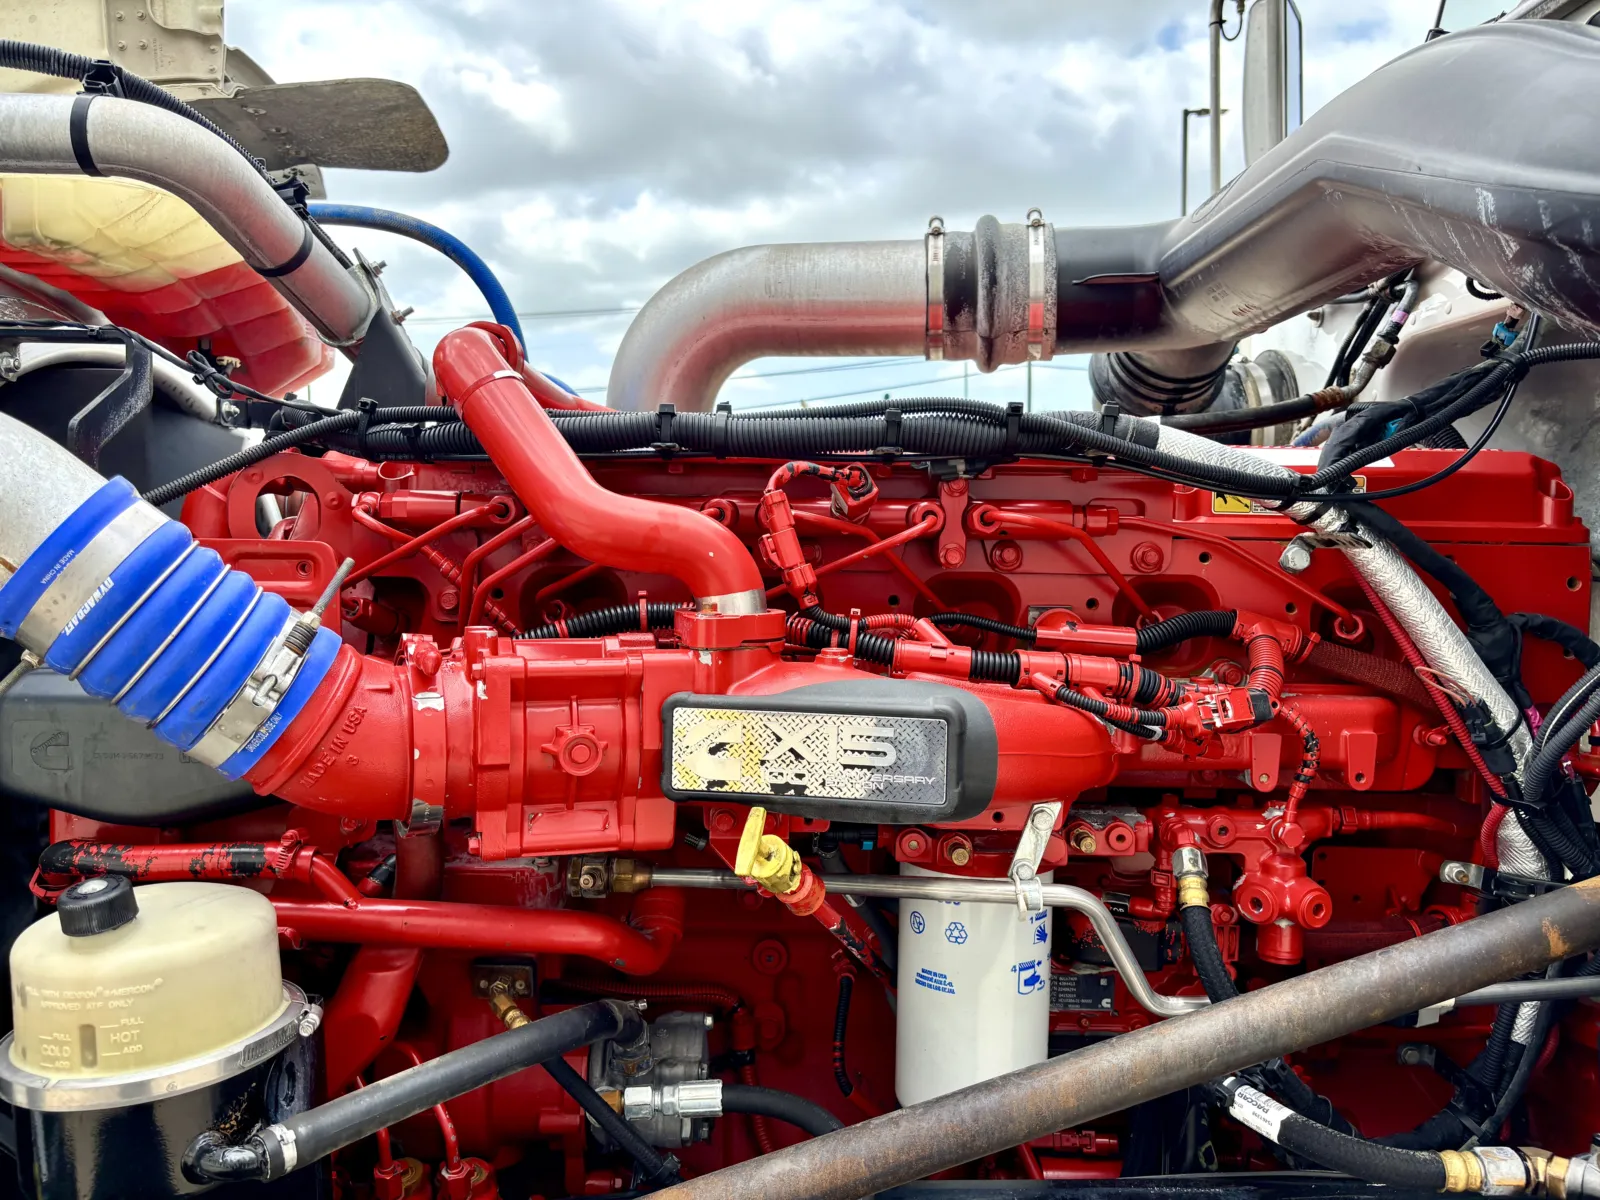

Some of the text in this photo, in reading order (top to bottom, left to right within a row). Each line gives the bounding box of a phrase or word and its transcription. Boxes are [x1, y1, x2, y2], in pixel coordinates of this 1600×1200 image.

[60, 549, 75, 565] MADE
[40, 569, 57, 585] CHINA
[63, 576, 115, 636] DYNACRAFT
[300, 705, 367, 788] MADE IN USA
[759, 720, 898, 767] X15
[1010, 964, 1018, 973] 4
[41, 998, 134, 1011] APPROVED ATF ONLY
[120, 1017, 144, 1026] FULL
[52, 1032, 72, 1041] FULL
[110, 1029, 140, 1044] HOT
[41, 1044, 71, 1058] COLD
[122, 1044, 143, 1054] ADD
[54, 1060, 71, 1068] ADD
[1237, 1092, 1270, 1114] PACCAR
